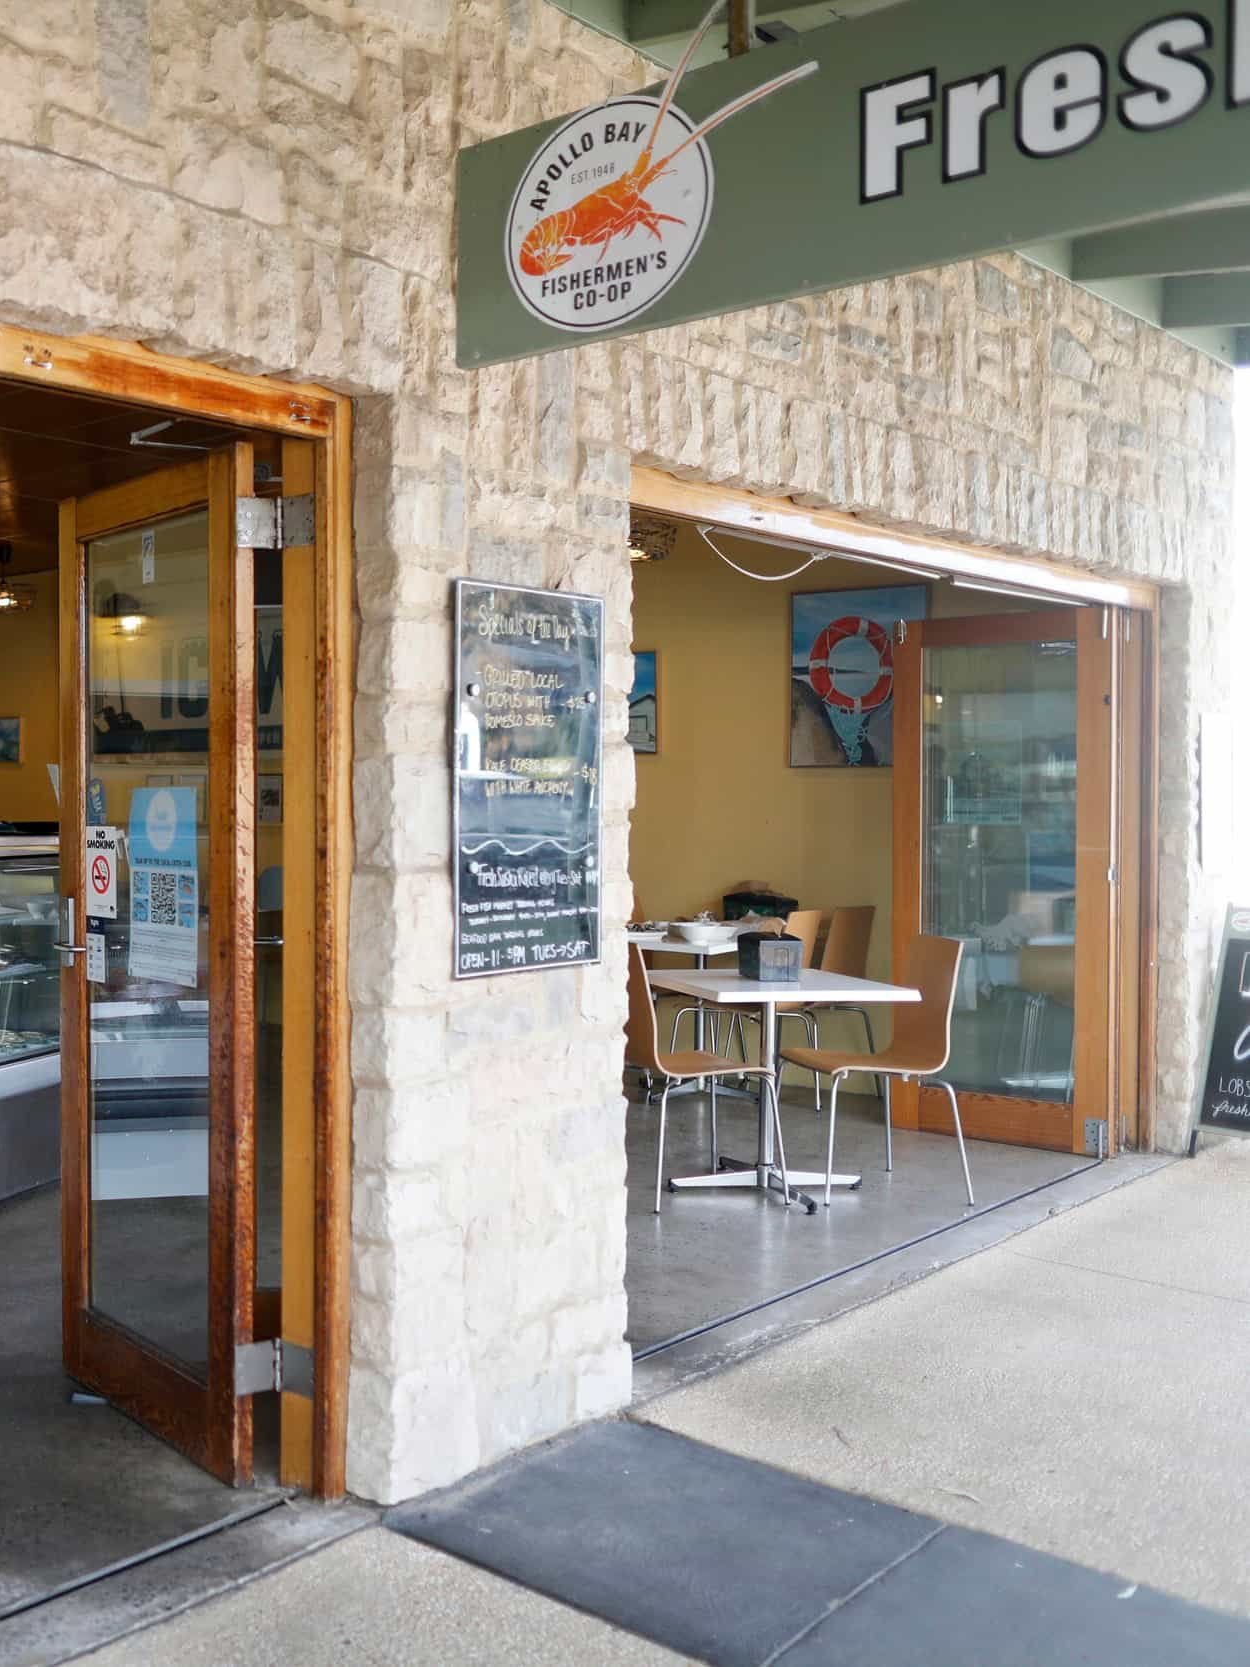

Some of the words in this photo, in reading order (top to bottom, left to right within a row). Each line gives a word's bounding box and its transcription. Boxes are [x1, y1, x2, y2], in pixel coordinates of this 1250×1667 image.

[859, 0, 1250, 205] Fres
[530, 132, 594, 211] APOLLO
[604, 121, 646, 144] BAY
[593, 163, 615, 179] 1948
[542, 250, 667, 297] FISHERMEN'S
[573, 281, 632, 310] CO-OP
[87, 839, 115, 850] SMOKING
[95, 830, 106, 840] NO
